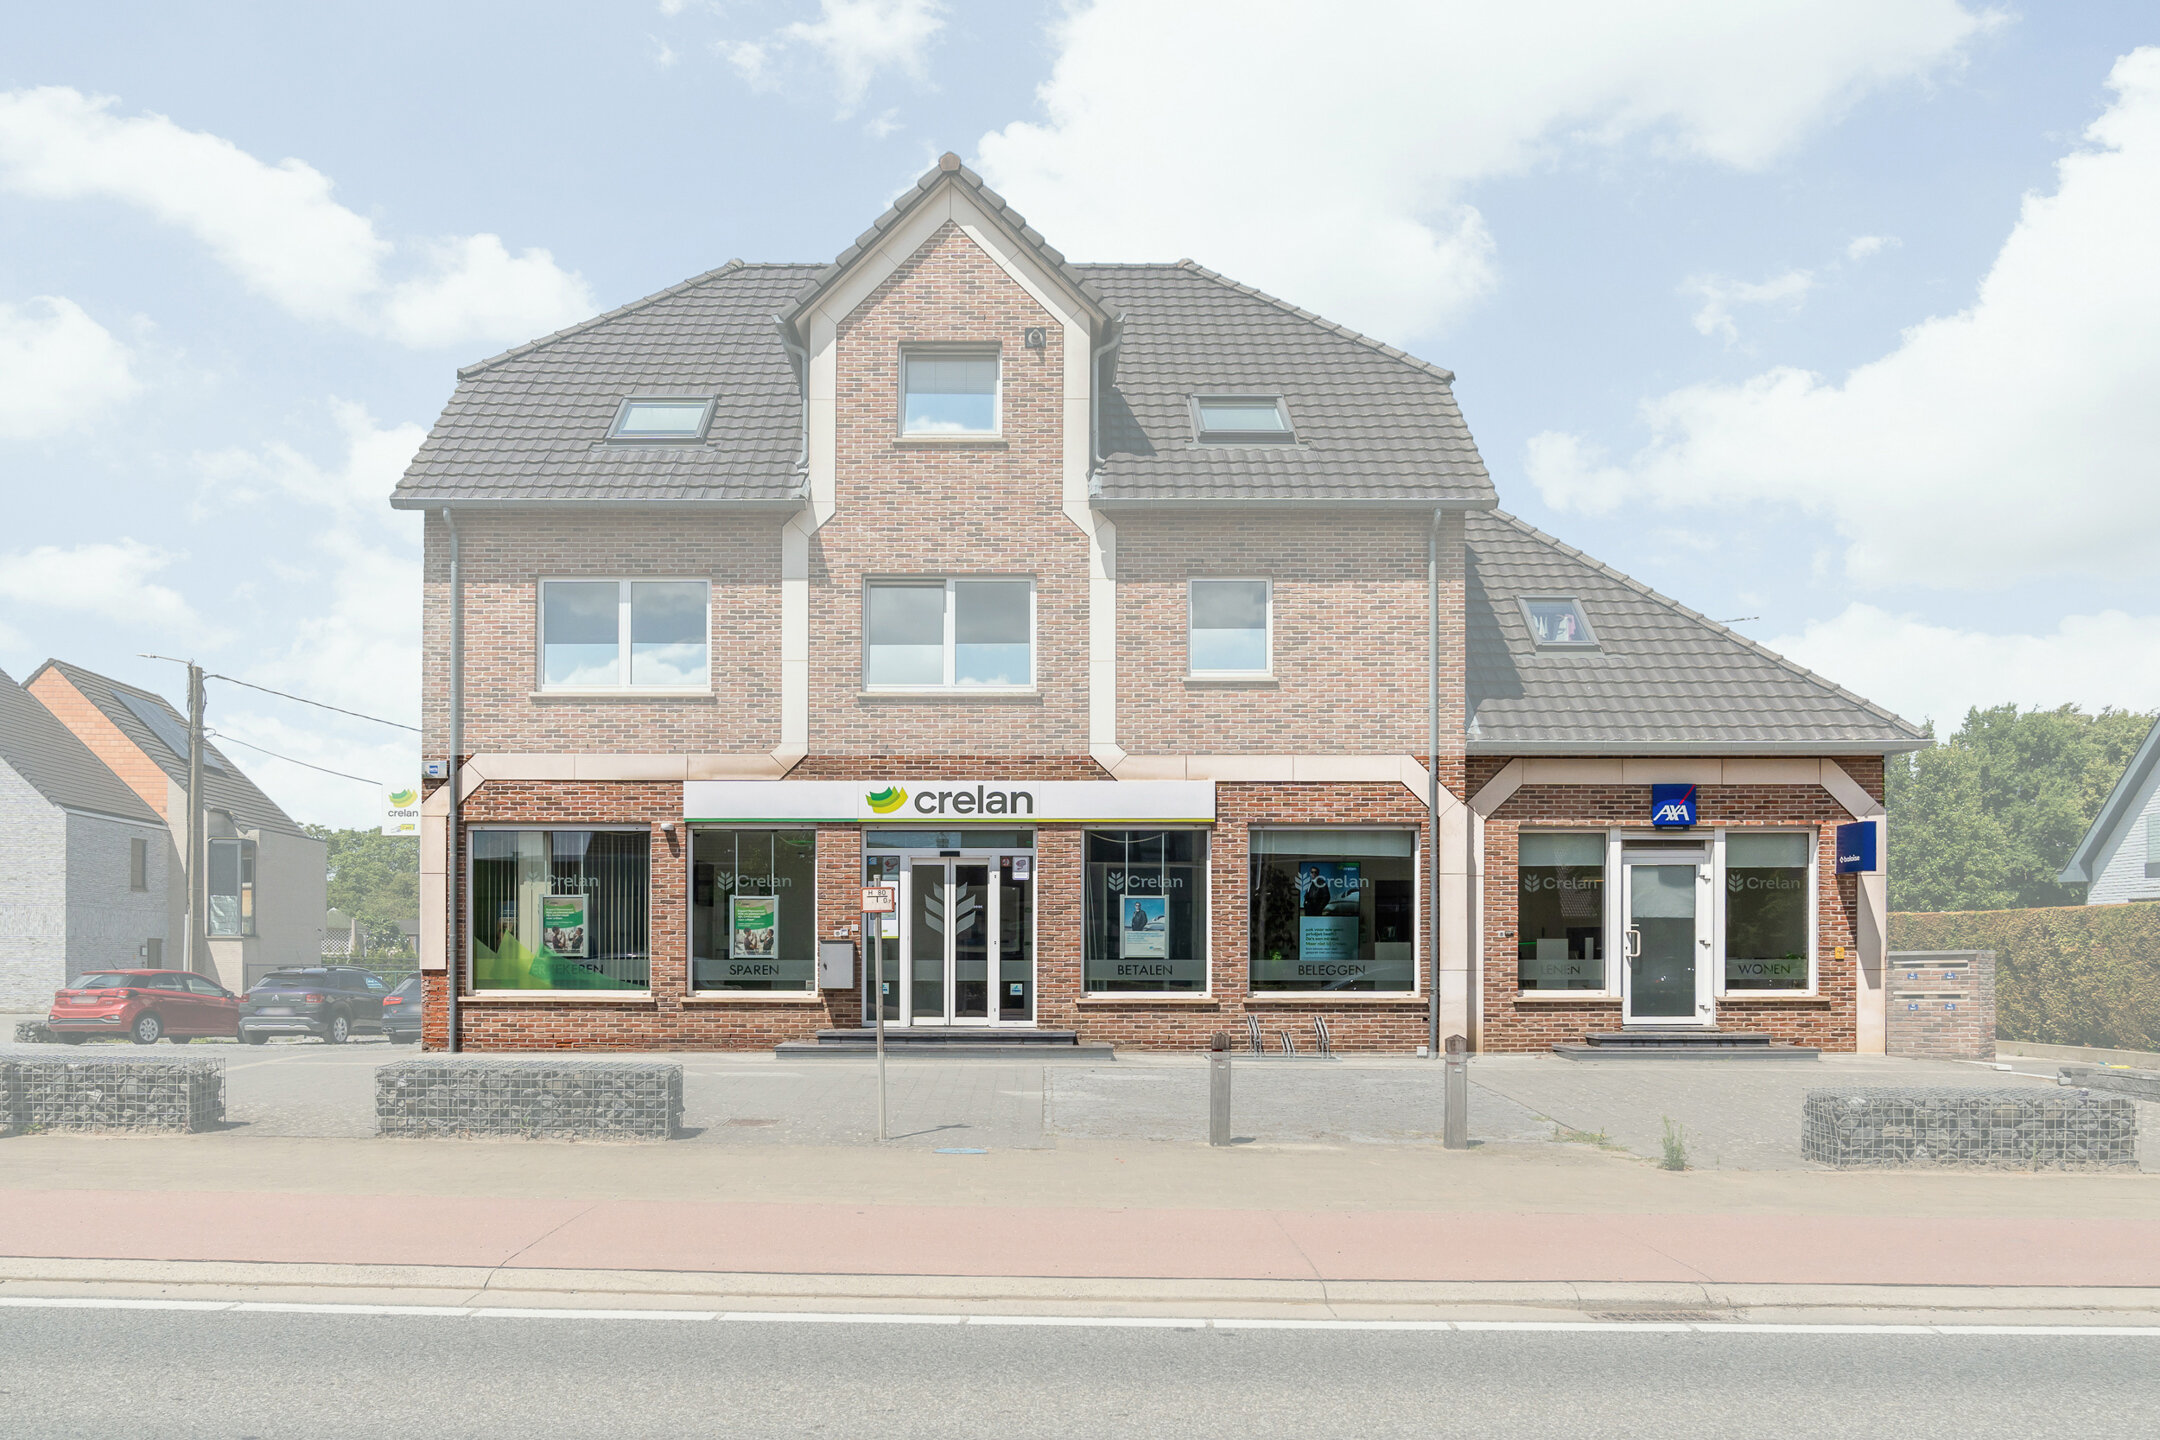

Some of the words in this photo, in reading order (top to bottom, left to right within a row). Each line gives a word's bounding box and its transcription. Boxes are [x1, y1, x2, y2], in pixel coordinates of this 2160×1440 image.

[914, 784, 1034, 815] crelan
[387, 808, 419, 818] crelan
[1653, 804, 1690, 821] AXA
[546, 874, 600, 888] Crelan
[737, 874, 792, 888] Crelan
[1127, 874, 1183, 888] Crelan
[1314, 874, 1369, 888] Crelan
[1543, 877, 1598, 890] Crelan
[1746, 876, 1801, 890] Crelan
[729, 964, 780, 976] SPAREN
[1117, 964, 1173, 976] BETALEN
[1298, 964, 1366, 976] BELEGGEN
[1540, 964, 1581, 975] LENEN
[1738, 964, 1791, 975] WONEN
